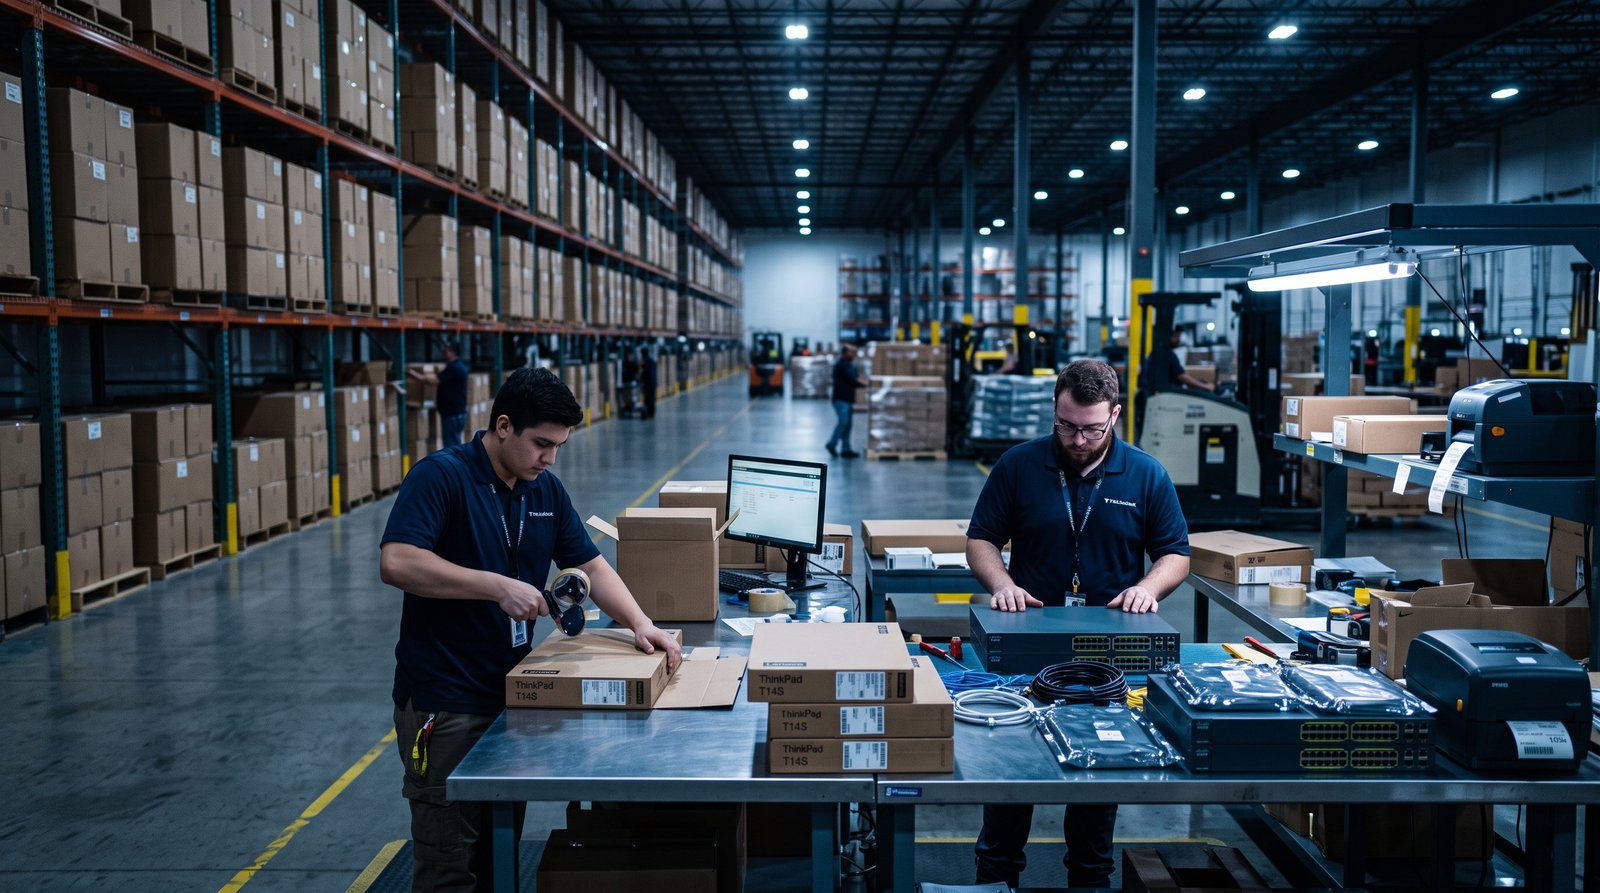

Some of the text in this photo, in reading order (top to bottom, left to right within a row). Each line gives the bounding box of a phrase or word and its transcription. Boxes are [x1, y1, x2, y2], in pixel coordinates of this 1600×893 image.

[759, 674, 803, 684] ThinkPad
[515, 681, 554, 689] ThinkPad
[515, 692, 538, 700] T14S
[759, 687, 785, 696] T14S
[782, 709, 822, 719] ThinkPad
[783, 722, 808, 731] T14S
[783, 744, 824, 753] ThinkPad
[783, 757, 809, 766] T14S
